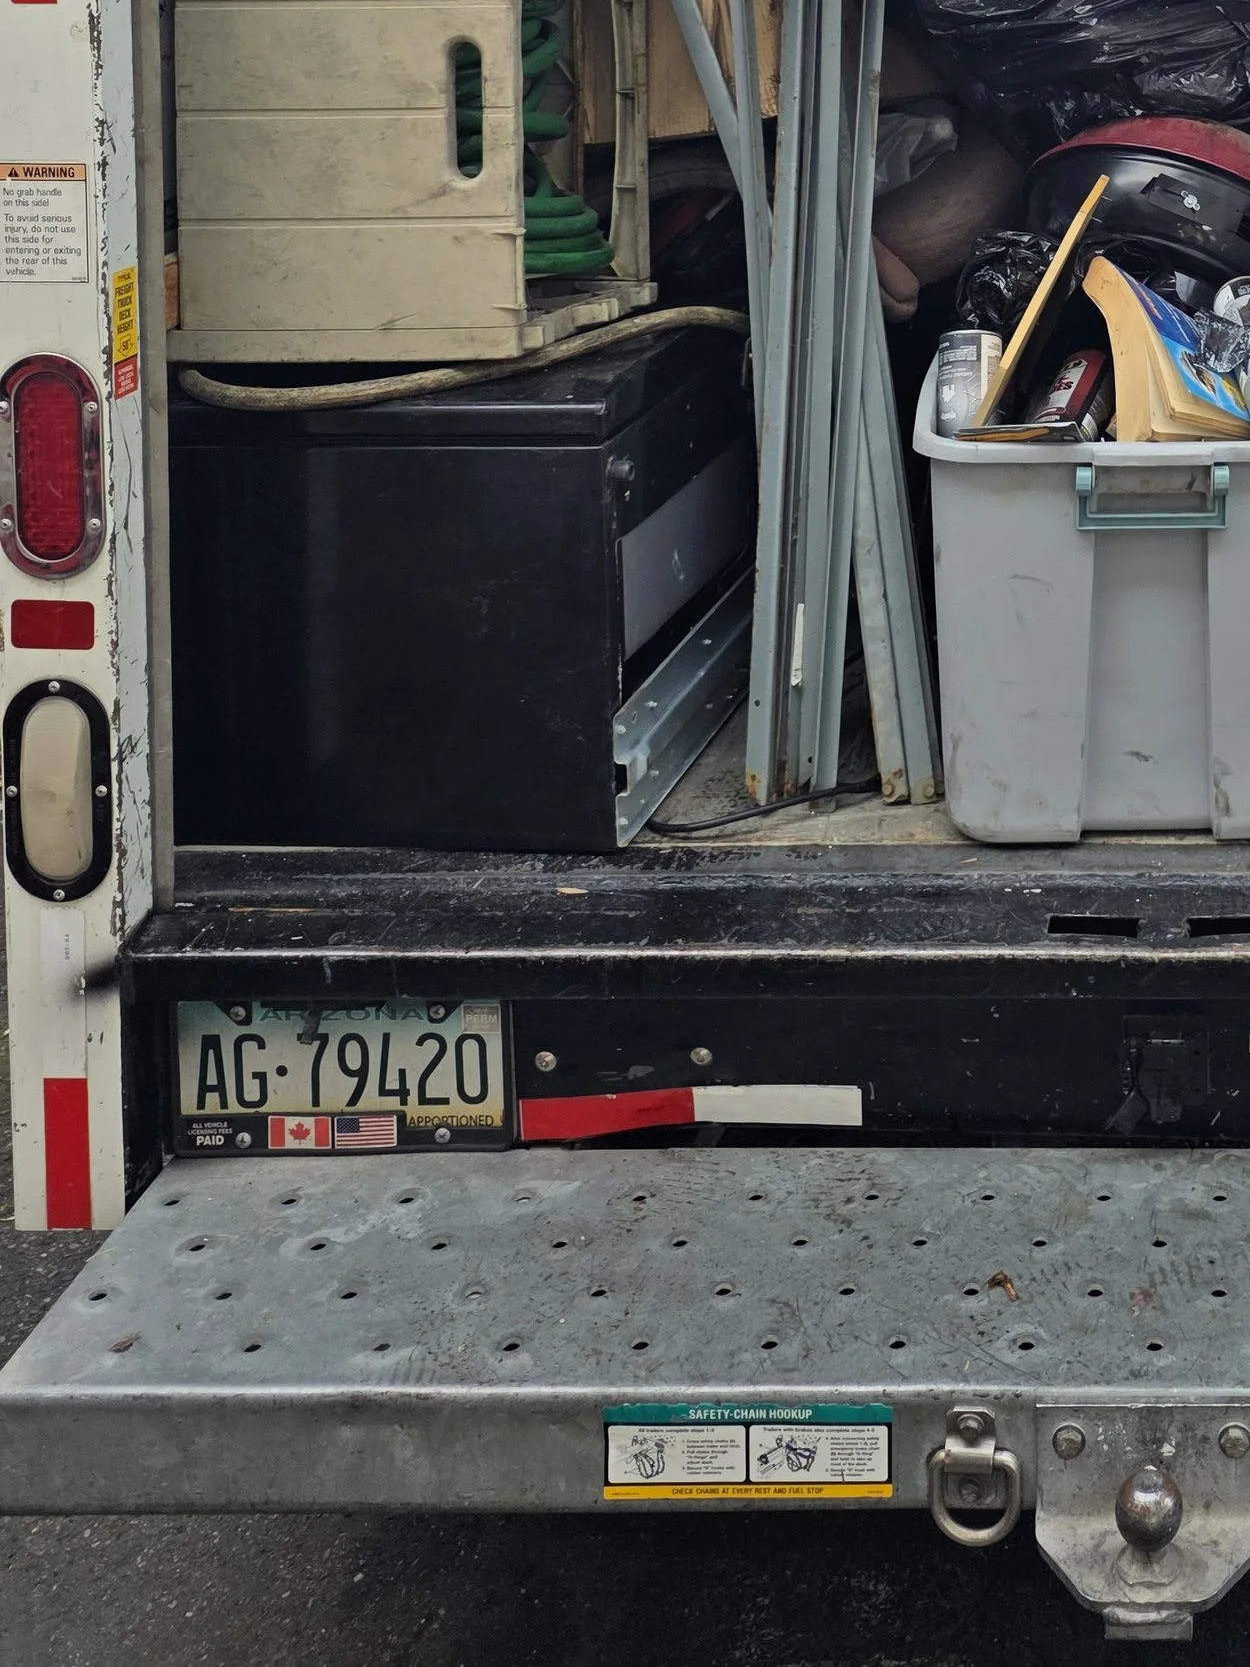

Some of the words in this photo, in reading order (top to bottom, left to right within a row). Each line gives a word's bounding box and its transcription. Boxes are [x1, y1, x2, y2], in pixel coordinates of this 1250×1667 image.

[23, 166, 76, 178] WARNING
[3, 188, 14, 196] No
[17, 188, 34, 198] grab
[36, 188, 62, 196] handle
[3, 199, 14, 207] on
[15, 198, 30, 207] this
[4, 214, 15, 222] To
[17, 214, 39, 222] avoid
[41, 214, 72, 222] serious
[4, 225, 29, 235] injury,
[31, 225, 42, 233] do
[5, 235, 20, 244] this
[22, 235, 40, 244] side
[41, 235, 54, 244] for
[5, 246, 40, 256] entering
[53, 246, 82, 256] exiting
[5, 257, 19, 265] the
[41, 257, 50, 265] of
[52, 257, 68, 265] this
[6, 267, 37, 276] vehicle.
[114, 282, 135, 298] FREIGHT
[117, 295, 133, 310] TRUCK
[118, 308, 132, 322] DECK
[117, 319, 134, 335] HEIGHT
[466, 1013, 497, 1024] PERM
[196, 1135, 225, 1146] PAID
[689, 1409, 767, 1420] SAFETY-CHAIN
[769, 1409, 813, 1420] HOOKUP
[672, 1487, 697, 1495] CHECK
[699, 1487, 720, 1495] CHAINS
[721, 1487, 730, 1495] AT
[732, 1487, 753, 1495] EVERY
[754, 1487, 772, 1495] REST
[774, 1487, 788, 1495] AND
[789, 1487, 805, 1495] FUEL
[807, 1487, 824, 1495] STOP
